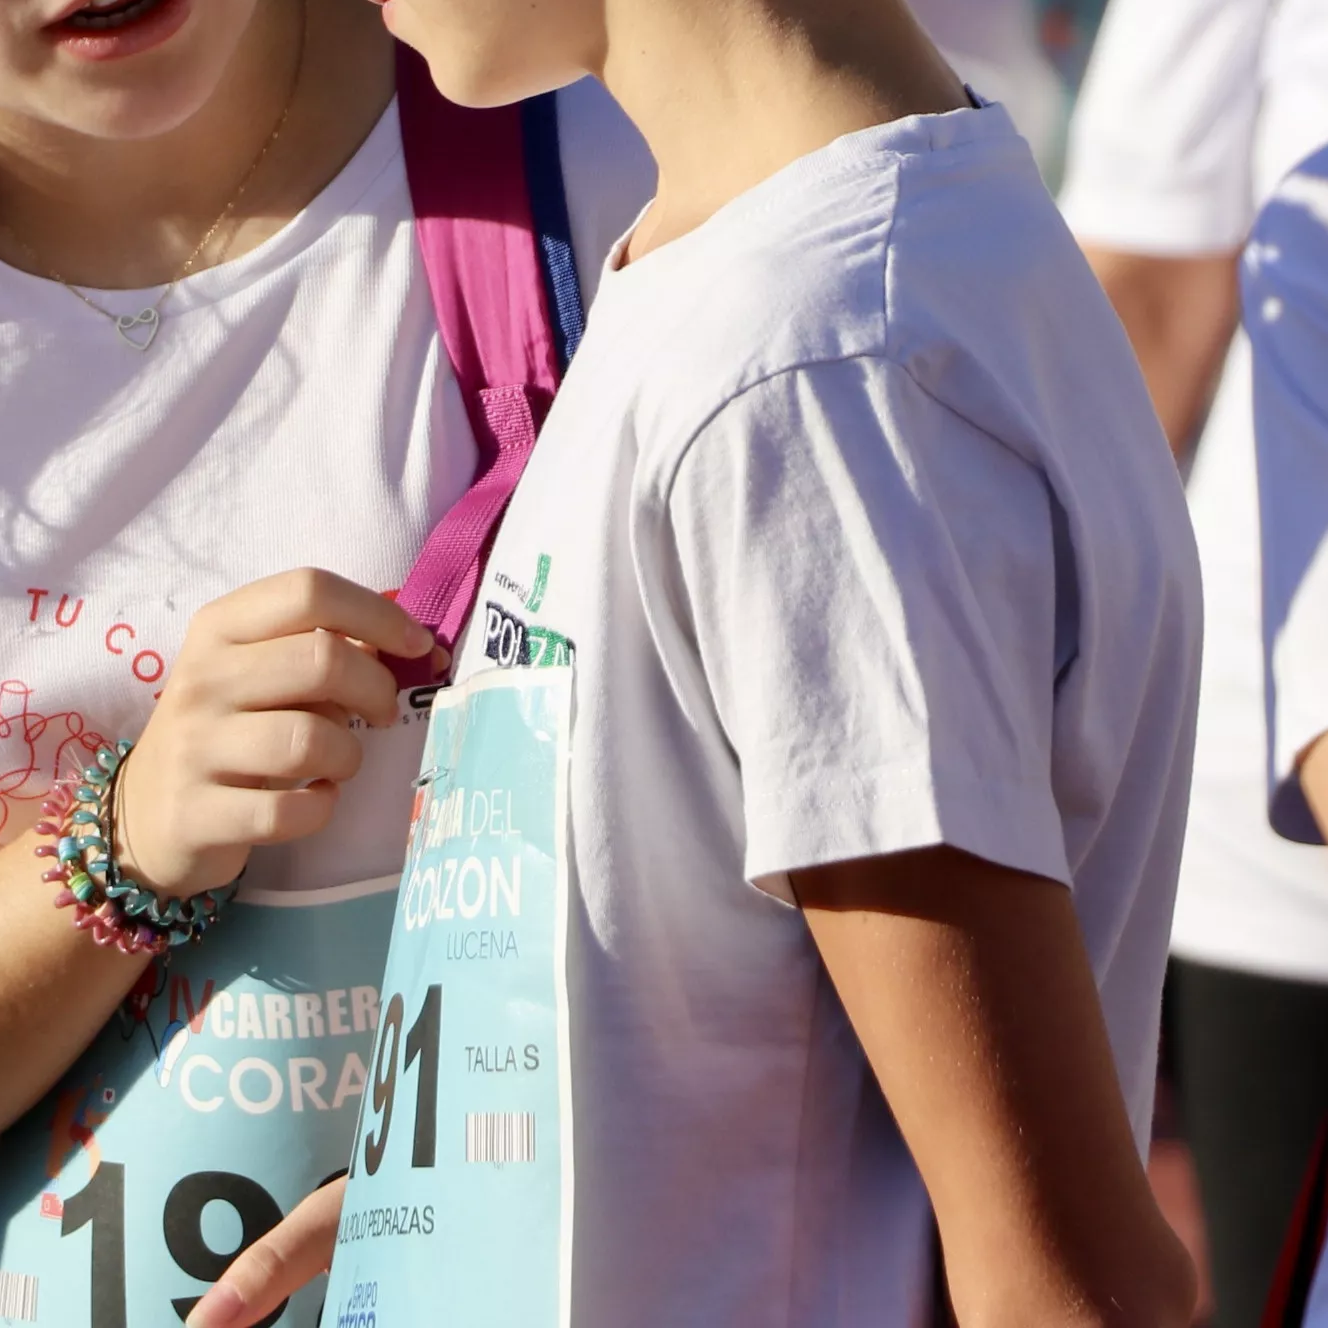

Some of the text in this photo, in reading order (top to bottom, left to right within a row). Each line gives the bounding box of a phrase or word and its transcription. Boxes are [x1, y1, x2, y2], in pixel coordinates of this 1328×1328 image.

[26, 588, 84, 628] TU
[446, 930, 520, 961] LUCENA
[168, 975, 381, 1041] IV CARRER
[465, 1043, 541, 1073] TALLA S
[179, 1052, 369, 1114] CORA
[367, 1204, 436, 1240] PEDRAZAS
[60, 1160, 350, 1328] 19
